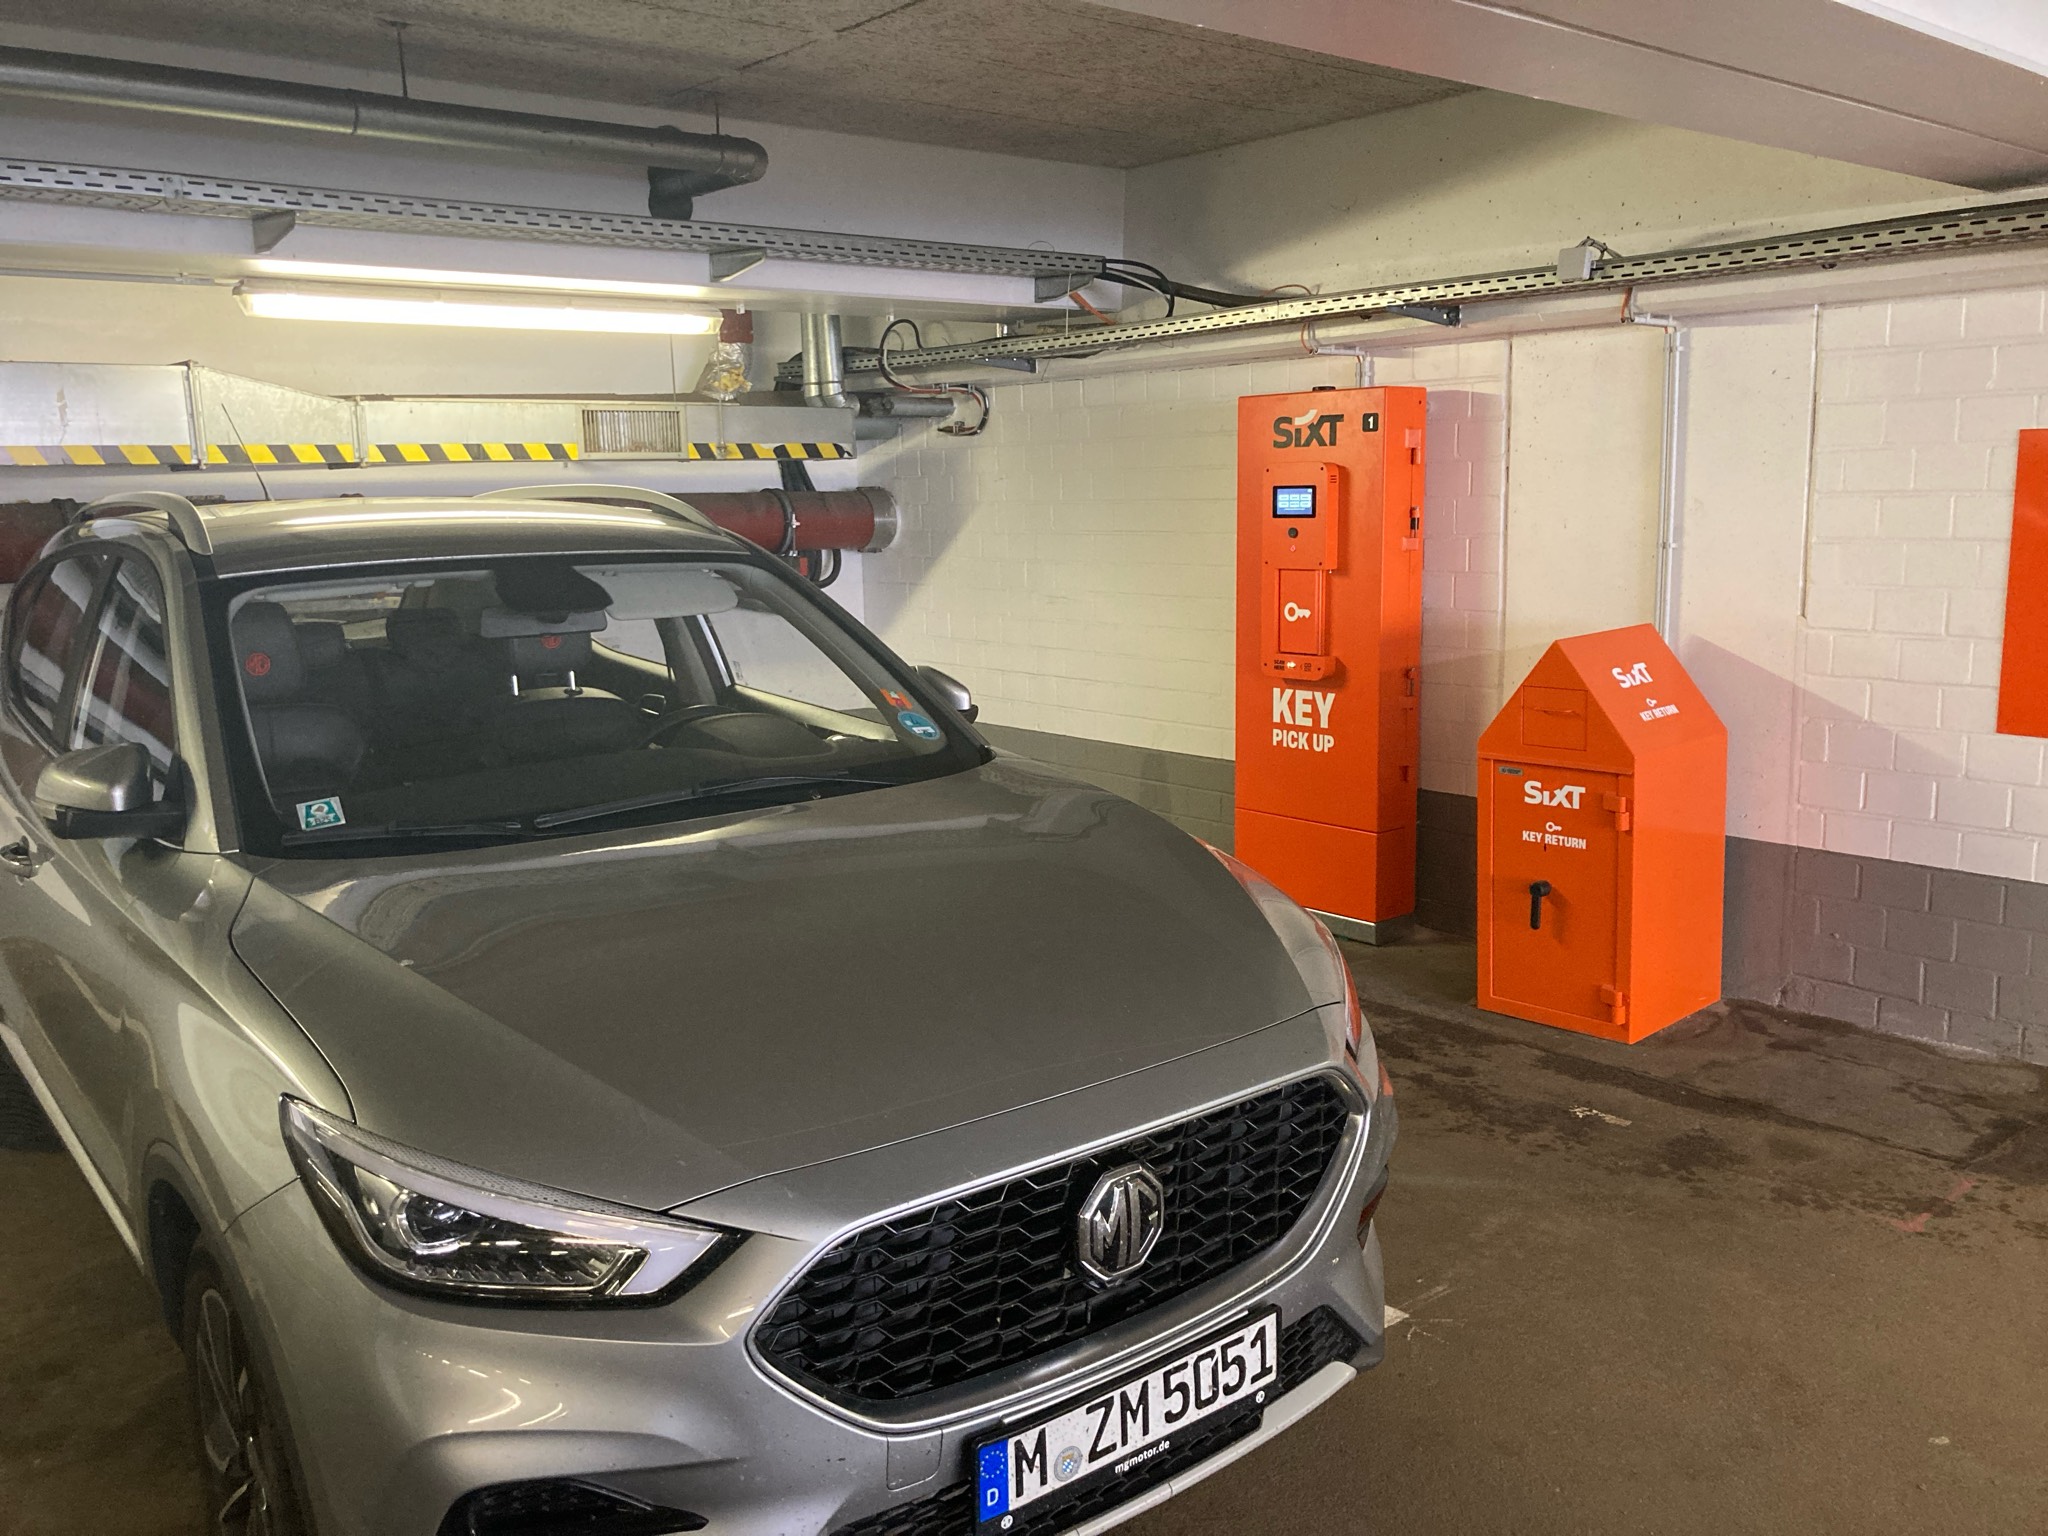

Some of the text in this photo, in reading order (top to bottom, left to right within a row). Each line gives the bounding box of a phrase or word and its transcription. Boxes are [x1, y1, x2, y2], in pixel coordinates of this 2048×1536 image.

[1367, 416, 1374, 429] 1
[1272, 687, 1336, 729] KEY
[1639, 704, 1680, 722] KEY RETURN
[1272, 728, 1335, 753] PICK UP
[1522, 830, 1586, 849] KEY RETURN
[1093, 1178, 1158, 1268] MG
[1013, 1427, 1048, 1499] M
[1085, 1379, 1150, 1464] ZM
[1162, 1325, 1274, 1424] 5051
[1114, 1440, 1170, 1474] mgmotor.de
[987, 1487, 999, 1507] D
